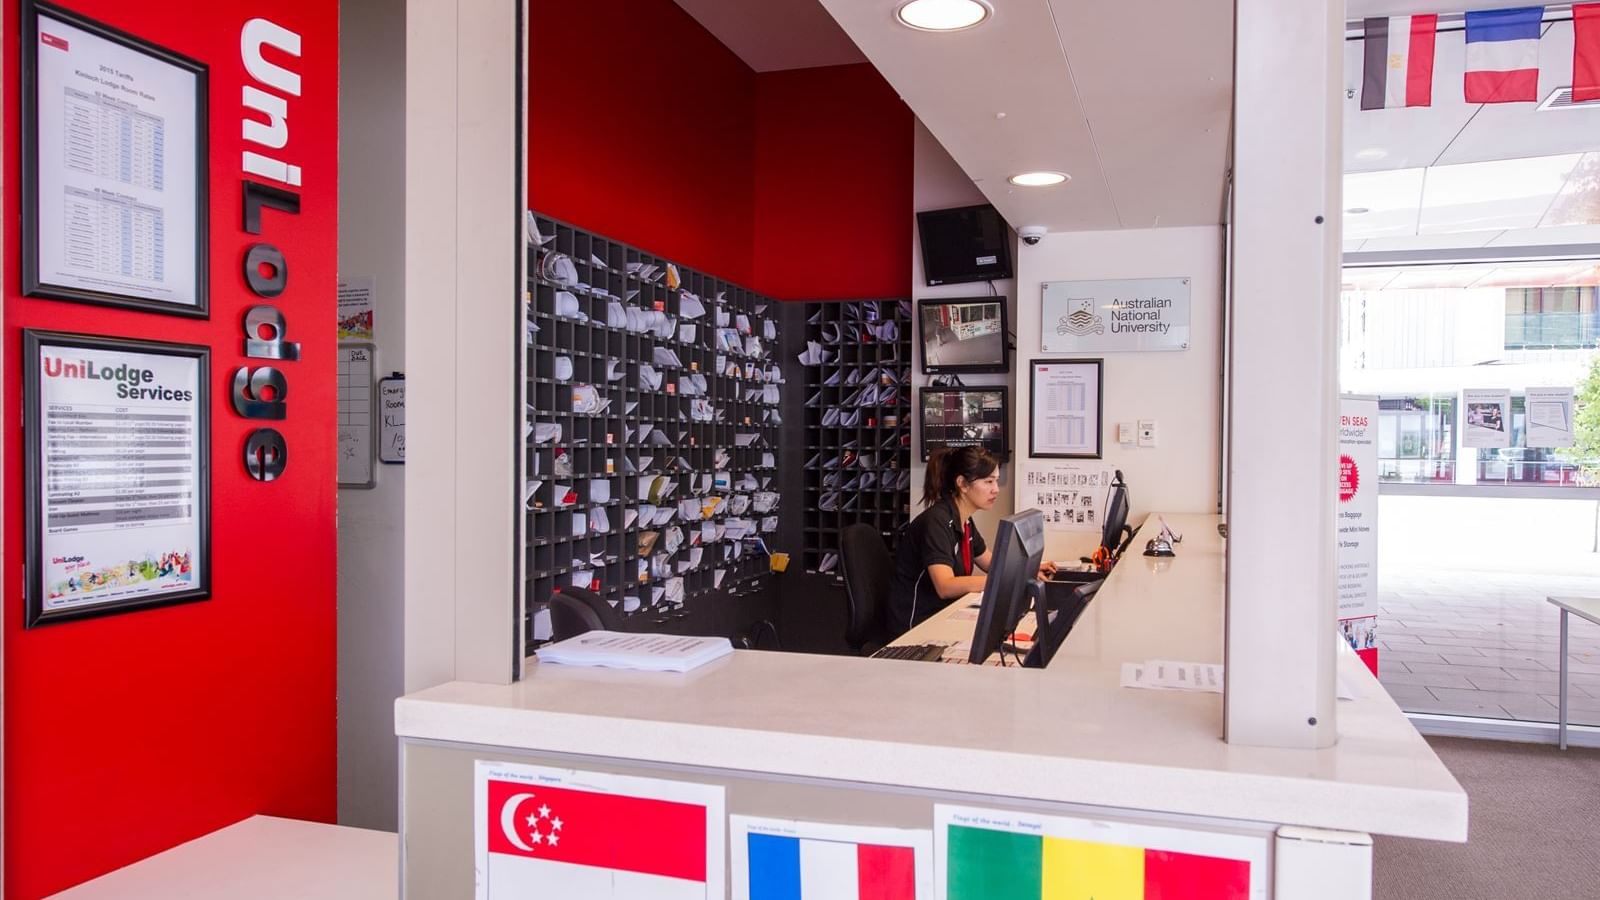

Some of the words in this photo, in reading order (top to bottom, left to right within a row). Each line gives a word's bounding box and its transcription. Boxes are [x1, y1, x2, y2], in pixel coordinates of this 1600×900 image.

[99, 64, 114, 75] 2015
[100, 78, 119, 90] Lodge
[234, 17, 302, 482] UniLodge
[1112, 297, 1172, 309] Australian
[1111, 309, 1160, 321] National
[1111, 321, 1170, 335] University
[44, 357, 154, 386] UniLodge
[116, 383, 193, 401] Services
[1352, 416, 1368, 427] SEAS
[52, 555, 84, 564] UniLodge
